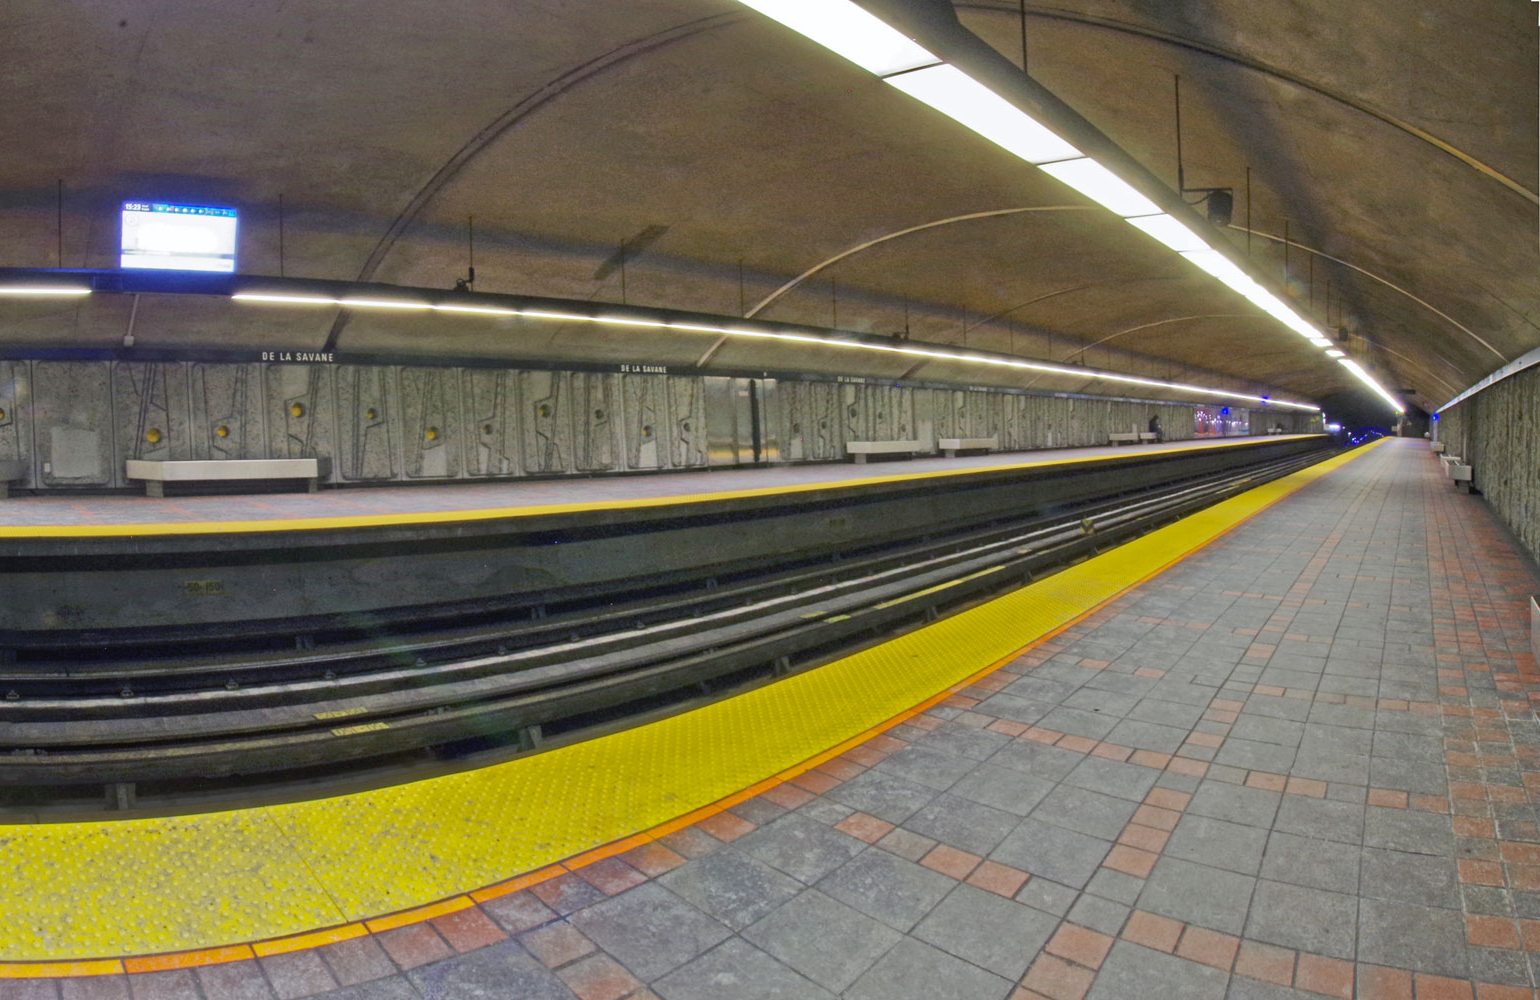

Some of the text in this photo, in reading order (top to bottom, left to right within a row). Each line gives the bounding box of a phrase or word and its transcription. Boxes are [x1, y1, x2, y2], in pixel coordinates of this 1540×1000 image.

[262, 351, 334, 362] DE LA SAVANE
[620, 364, 667, 374] DE LA SAVANE
